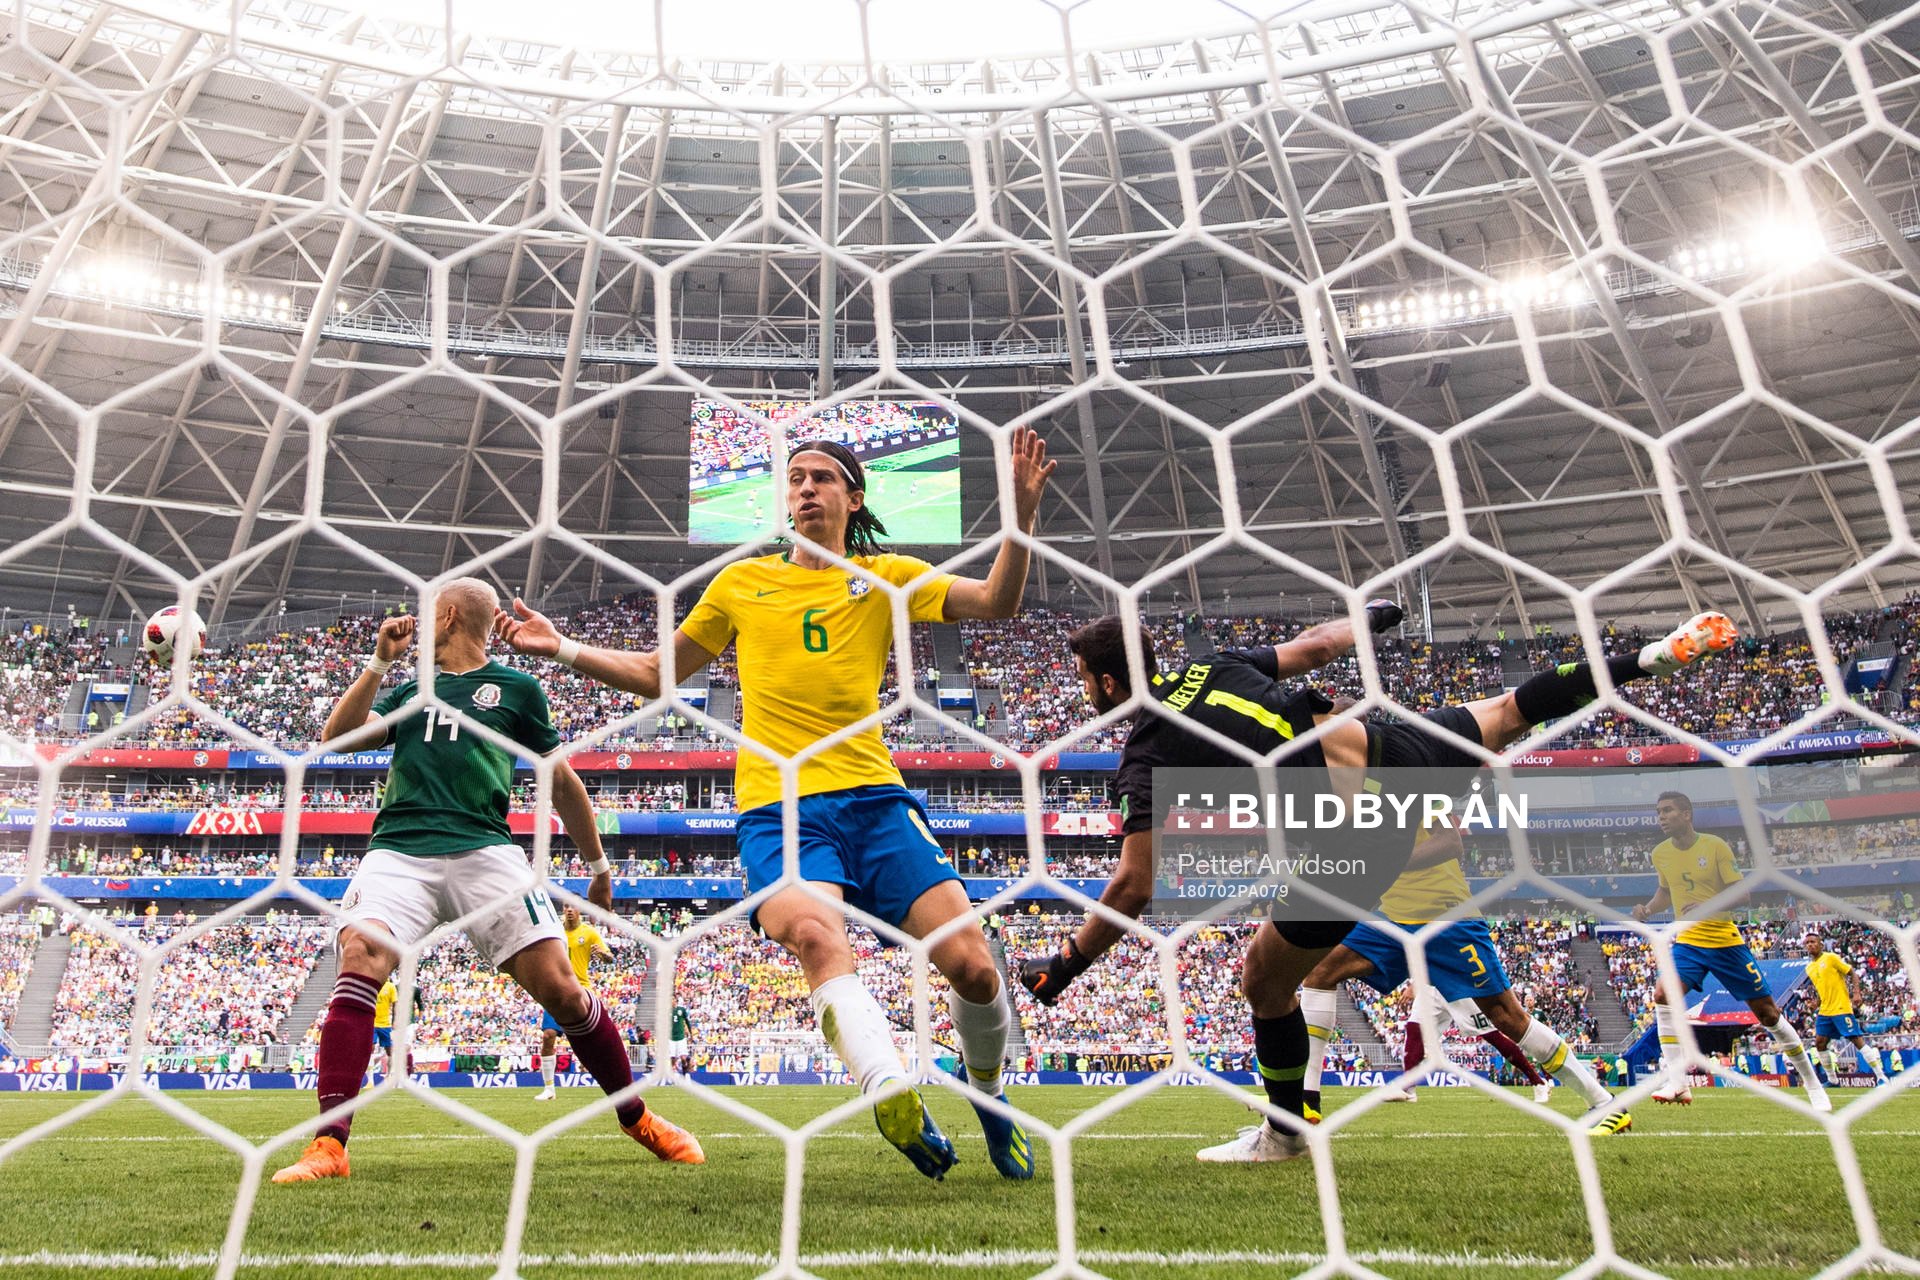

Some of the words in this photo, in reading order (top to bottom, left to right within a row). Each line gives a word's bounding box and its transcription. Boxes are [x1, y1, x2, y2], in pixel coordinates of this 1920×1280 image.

[715, 410, 735, 419] BRA
[803, 609, 828, 653] 6
[423, 705, 463, 742] 14
[1204, 689, 1295, 741] 1
[1834, 735, 1852, 746] ПО
[1512, 754, 1553, 766] orldcup
[84, 817, 127, 827] RUSSIA
[1547, 818, 1572, 829] FIFA
[1573, 818, 1614, 828] WORLD
[1615, 816, 1639, 827] CUP
[1682, 872, 1695, 892] 5
[1459, 943, 1487, 977] 3
[1746, 961, 1762, 983] 5
[1470, 1012, 1489, 1031] 16
[16, 1073, 68, 1091] VISA
[200, 1073, 251, 1090] VISA
[468, 1073, 518, 1088] VISA
[1076, 1072, 1127, 1086] VISA
[1336, 1072, 1386, 1087] VISA
